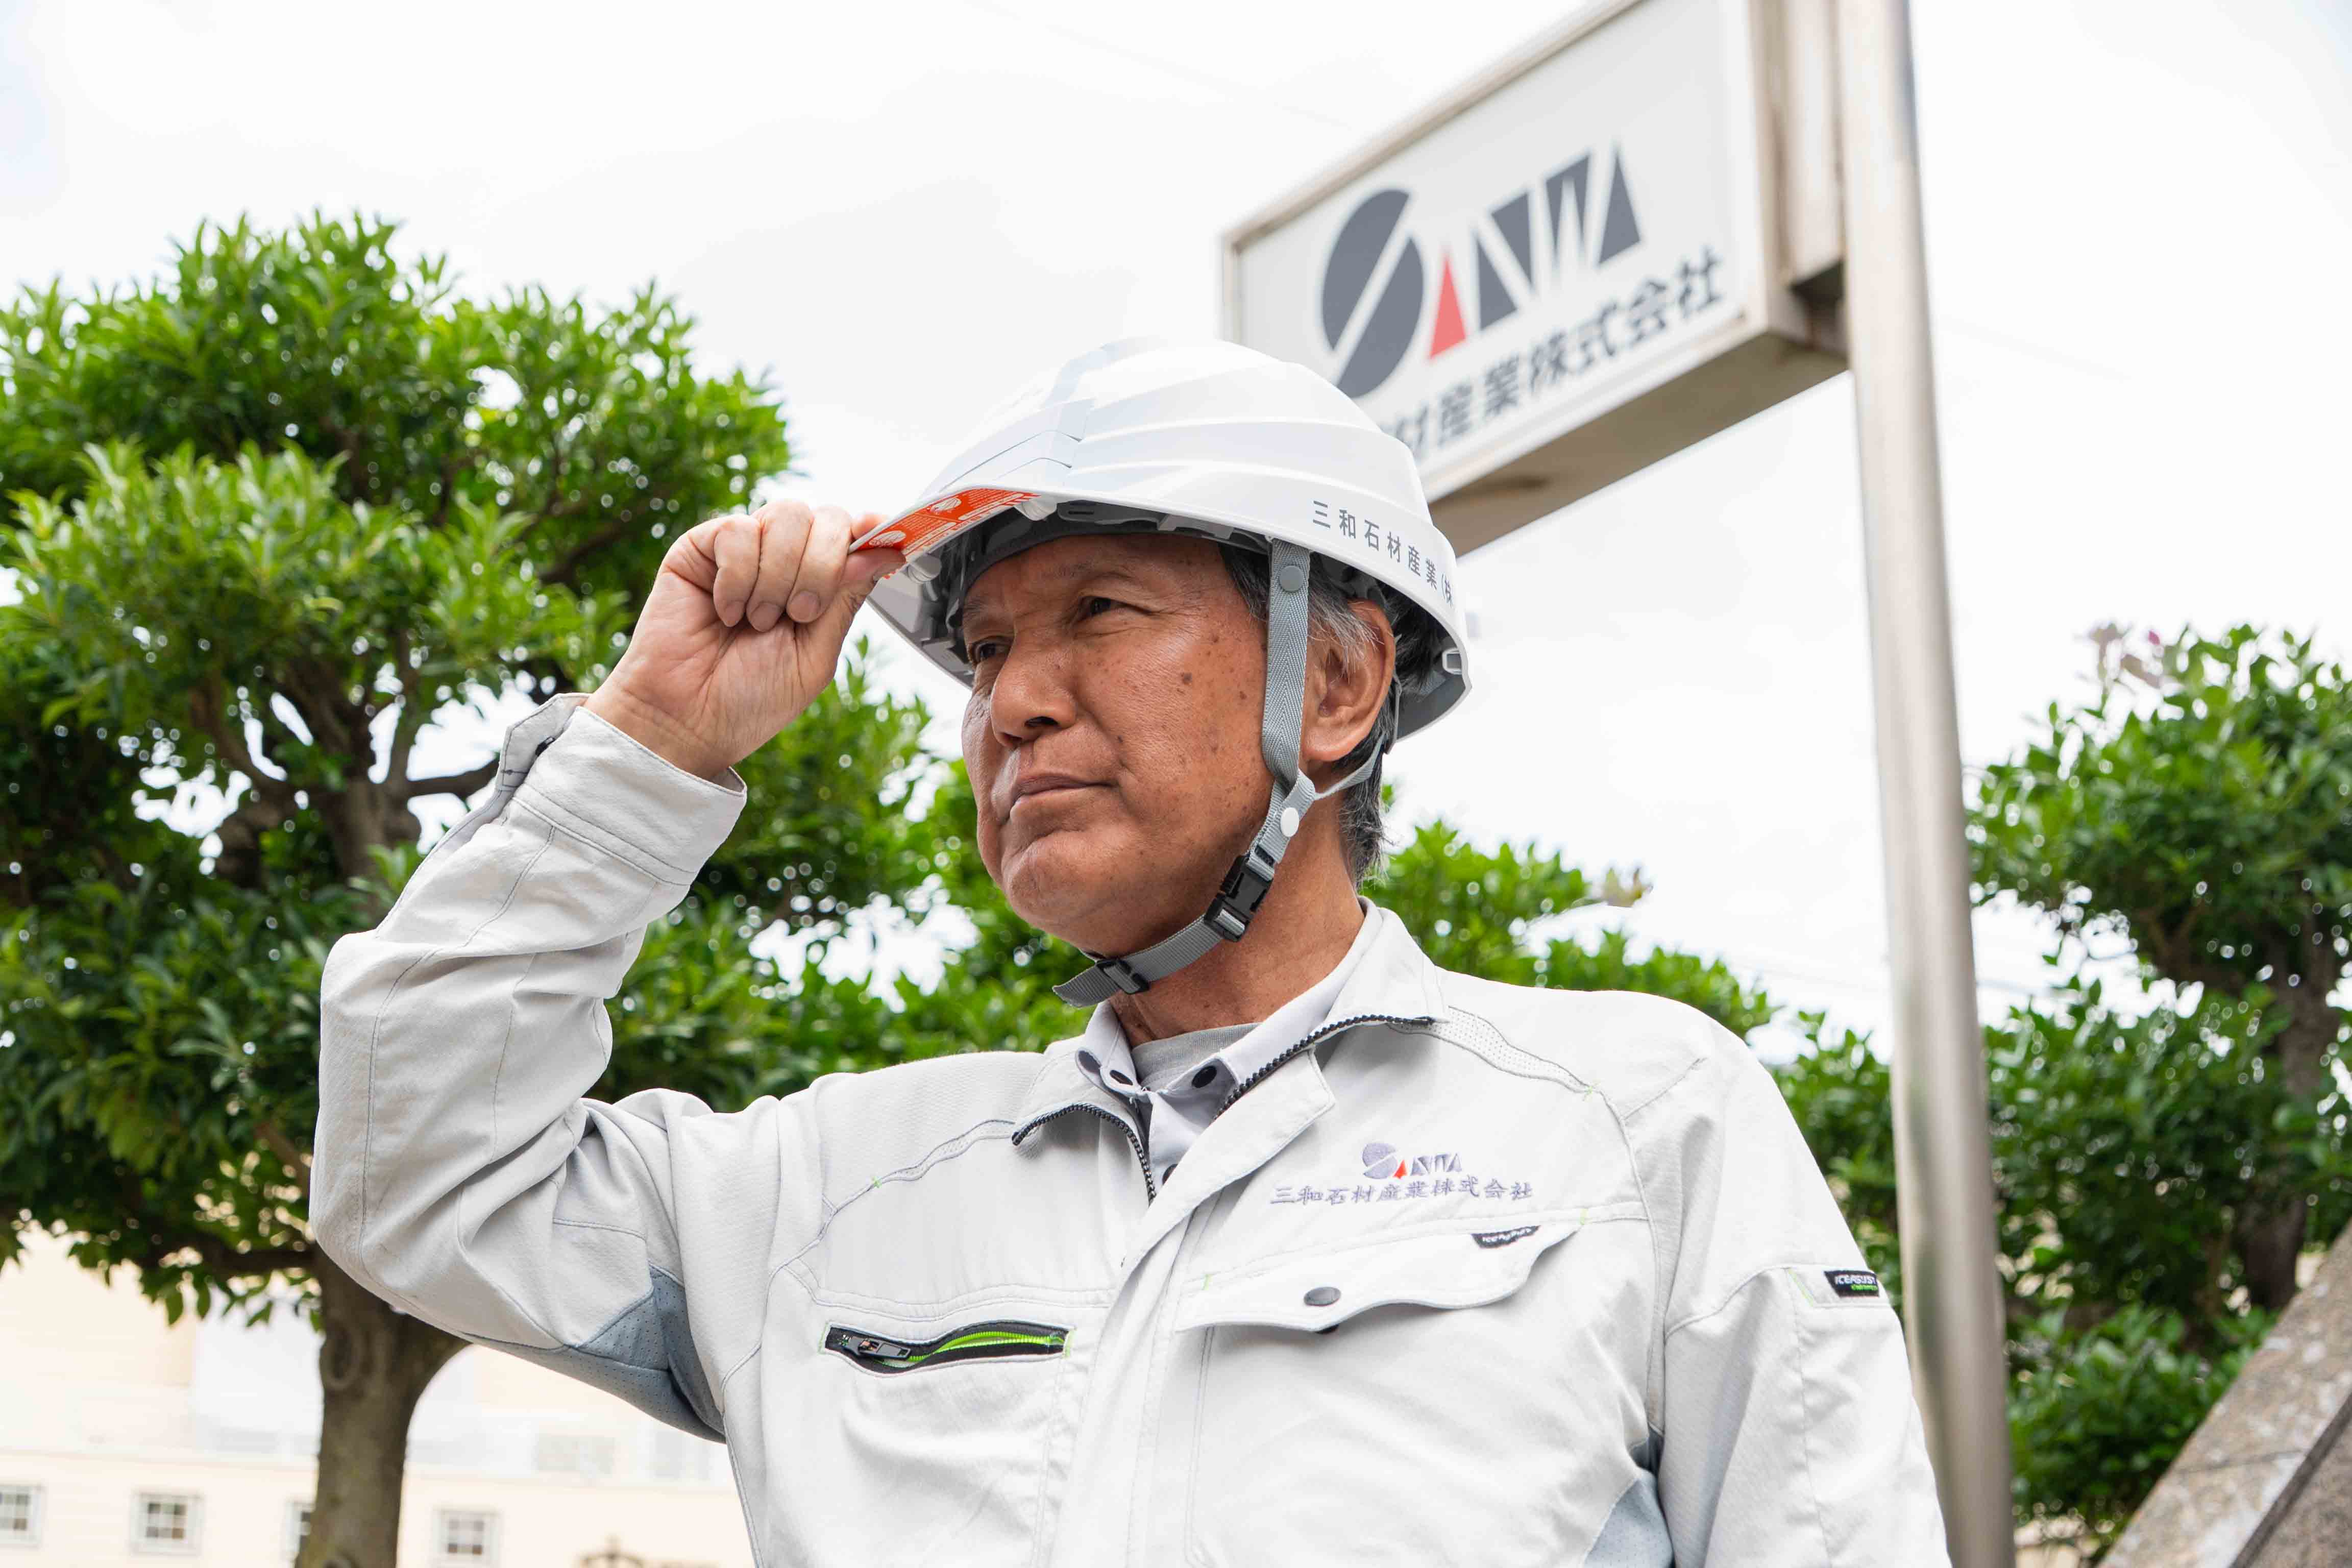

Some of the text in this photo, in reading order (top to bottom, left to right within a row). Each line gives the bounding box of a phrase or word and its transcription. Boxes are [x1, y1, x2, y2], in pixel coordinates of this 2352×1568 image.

[1270, 1175, 1533, 1205] 三和石材産業株式会社
